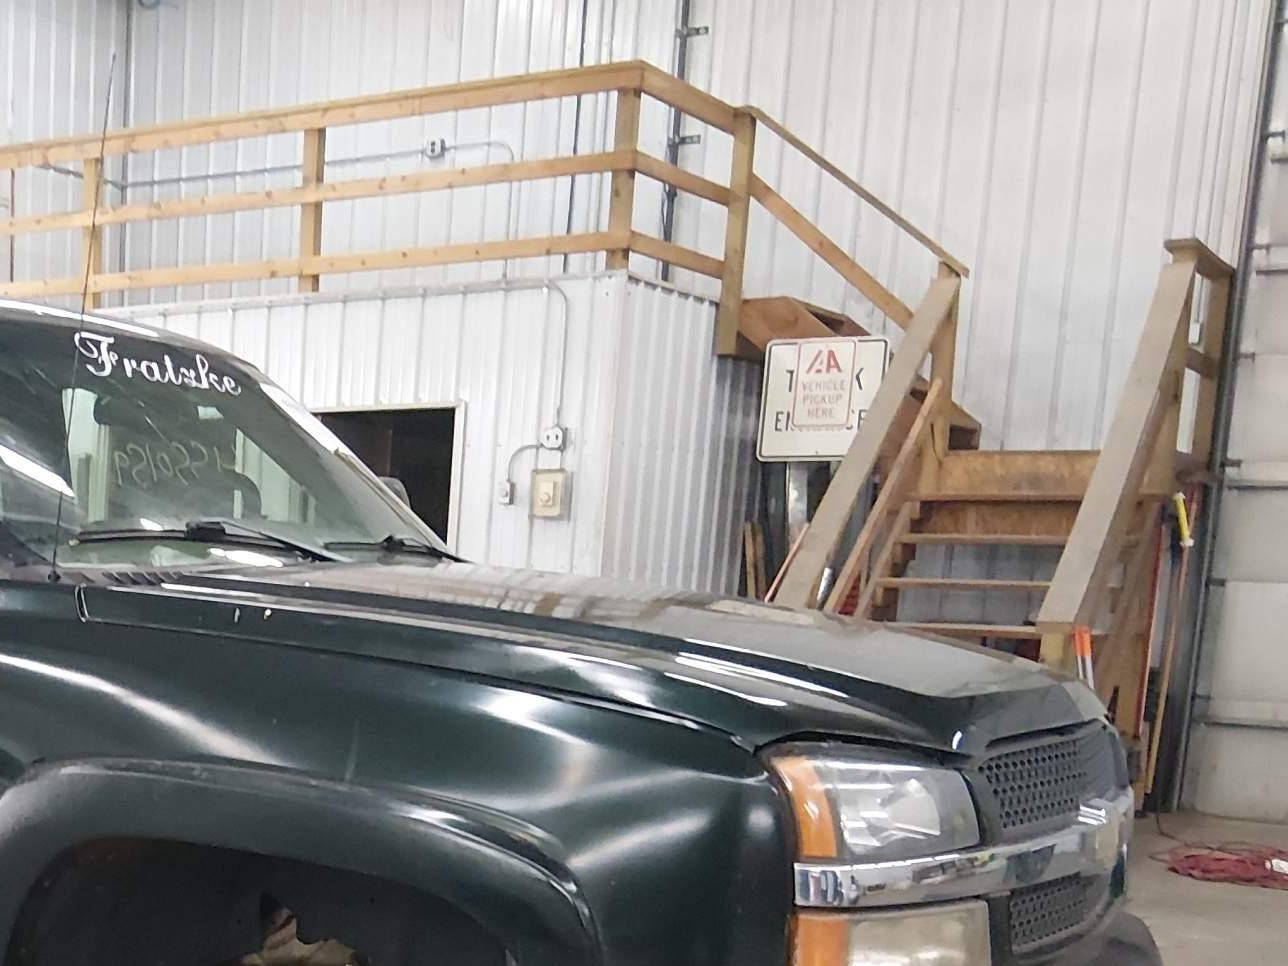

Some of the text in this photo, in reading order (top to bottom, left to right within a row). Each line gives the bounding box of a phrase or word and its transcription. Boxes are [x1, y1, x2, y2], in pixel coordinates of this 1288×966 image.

[801, 379, 846, 393] VEHICLE
[802, 394, 843, 407] PICKUP
[807, 407, 835, 419] HERE
